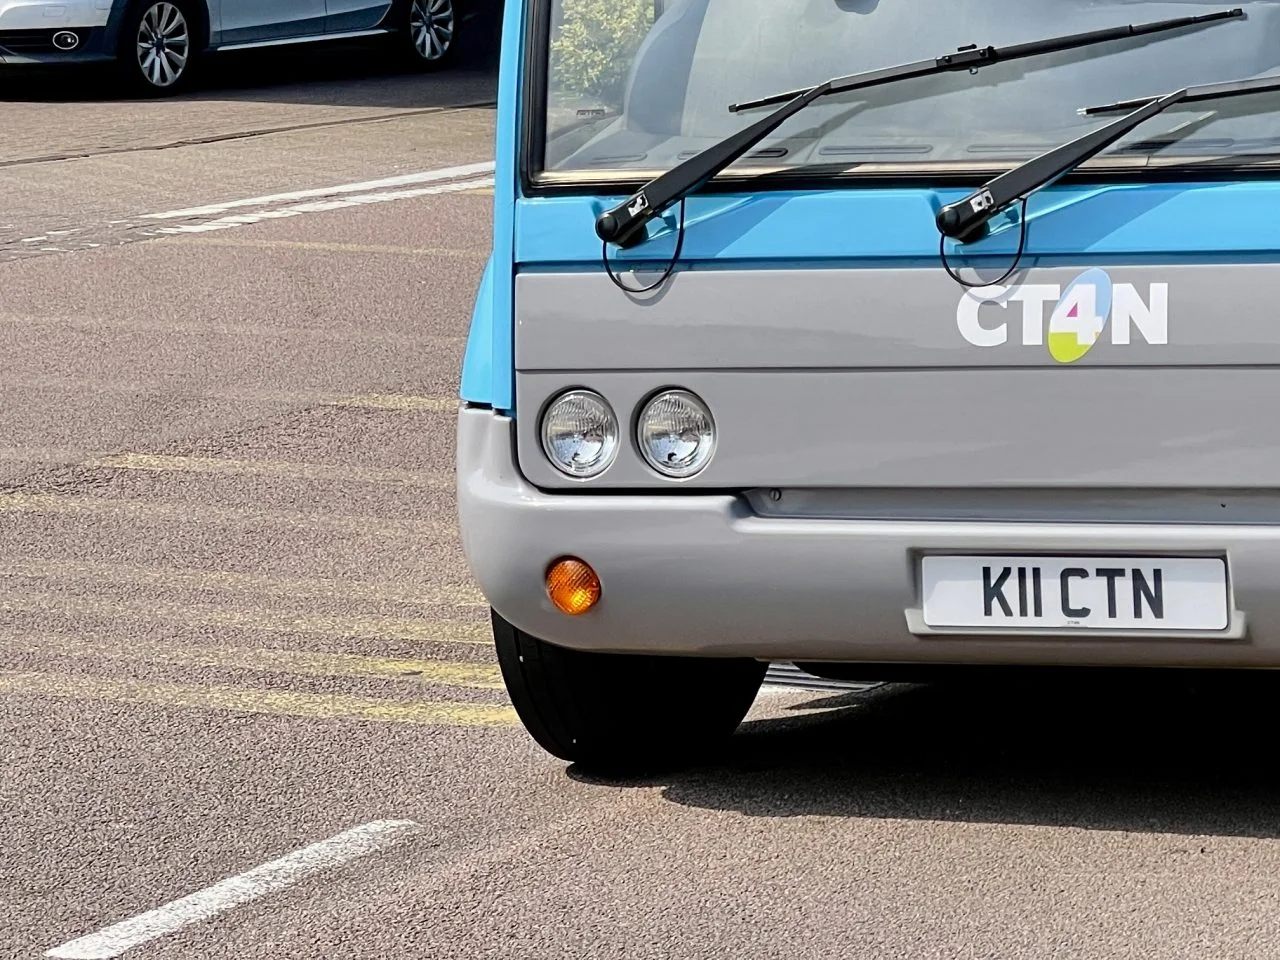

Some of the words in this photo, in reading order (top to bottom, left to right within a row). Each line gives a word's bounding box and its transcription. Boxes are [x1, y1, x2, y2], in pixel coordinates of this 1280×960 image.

[956, 282, 1168, 347] CT4N
[982, 566, 1042, 617] K11
[1060, 567, 1164, 619] CTN
